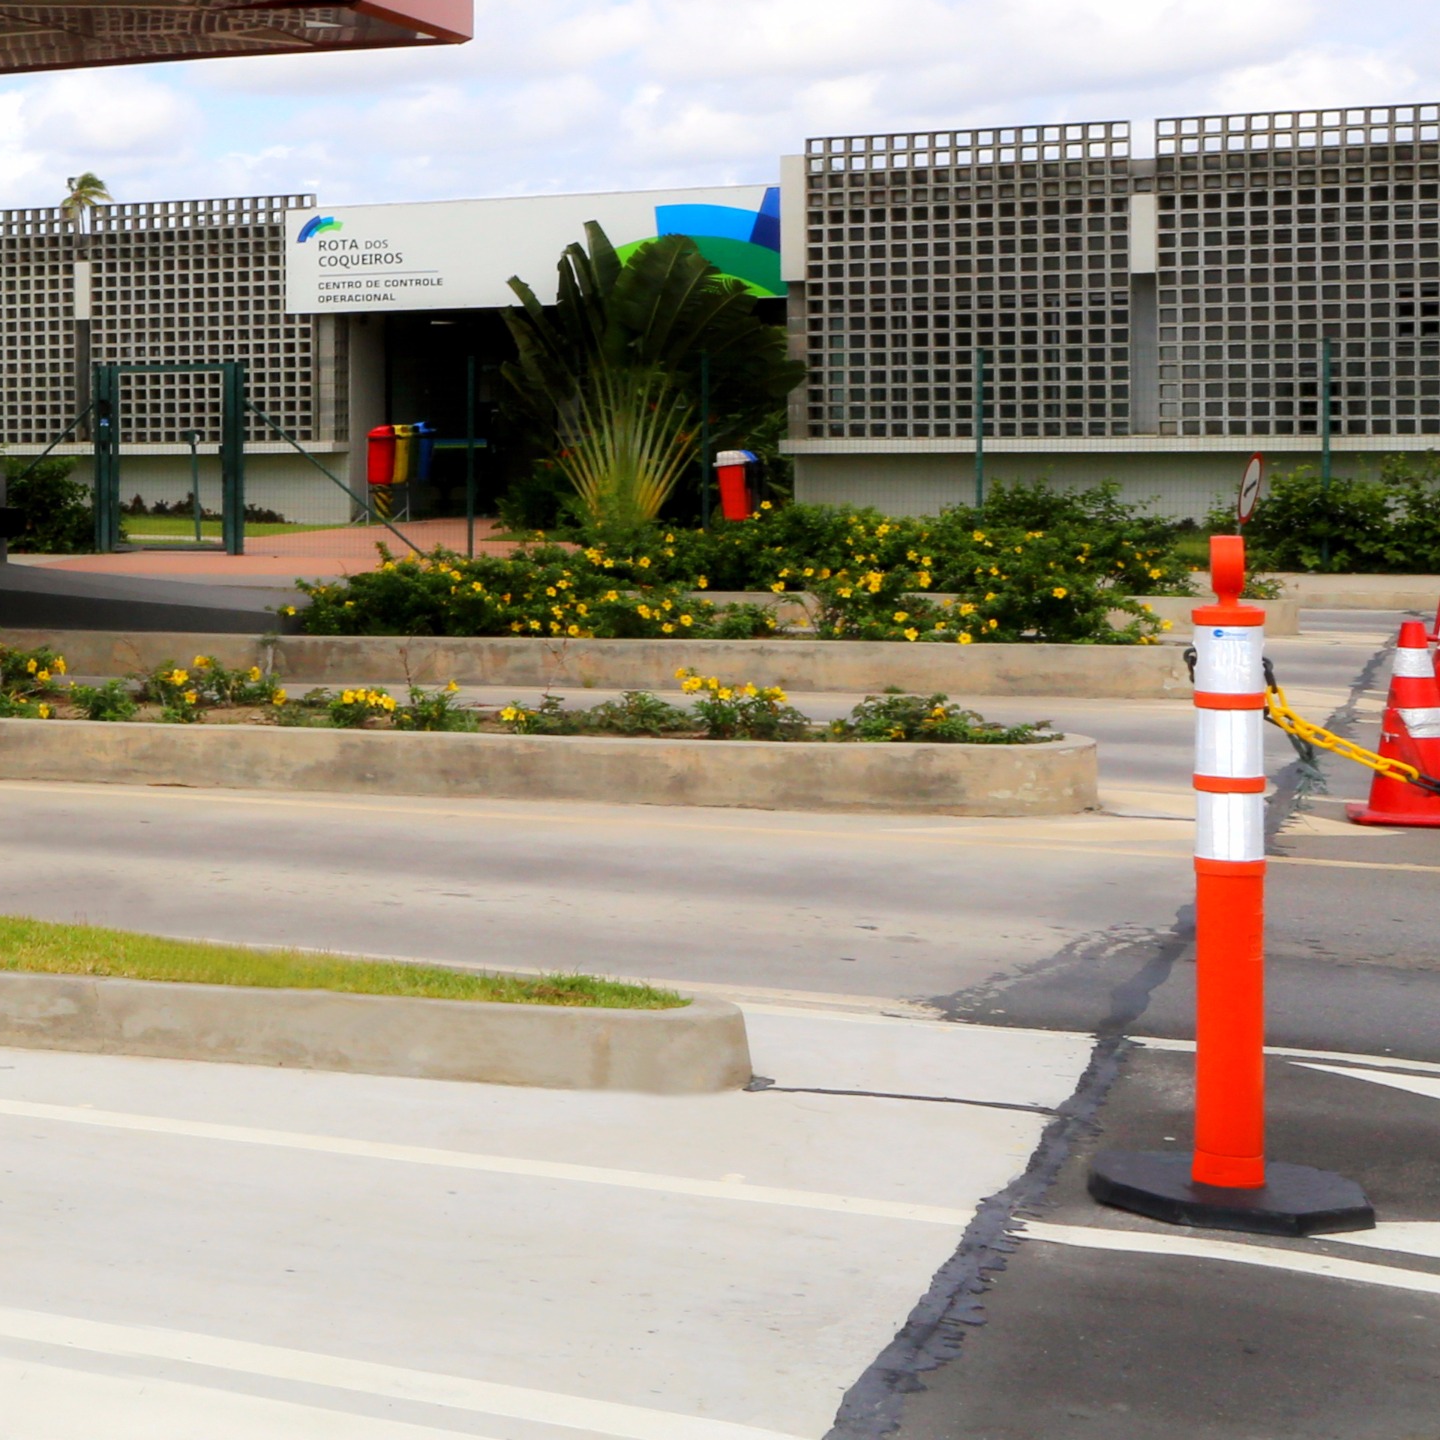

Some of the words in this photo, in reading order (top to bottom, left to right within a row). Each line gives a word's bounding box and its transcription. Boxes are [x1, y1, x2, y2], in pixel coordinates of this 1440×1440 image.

[318, 239, 359, 251] ROTA
[364, 239, 389, 250] DOS
[318, 252, 403, 269] COQUEIROS
[318, 280, 362, 291] CENTRO
[366, 279, 380, 289] DE
[384, 277, 443, 288] CONTROLE
[318, 292, 396, 304] OPERACIONAL
